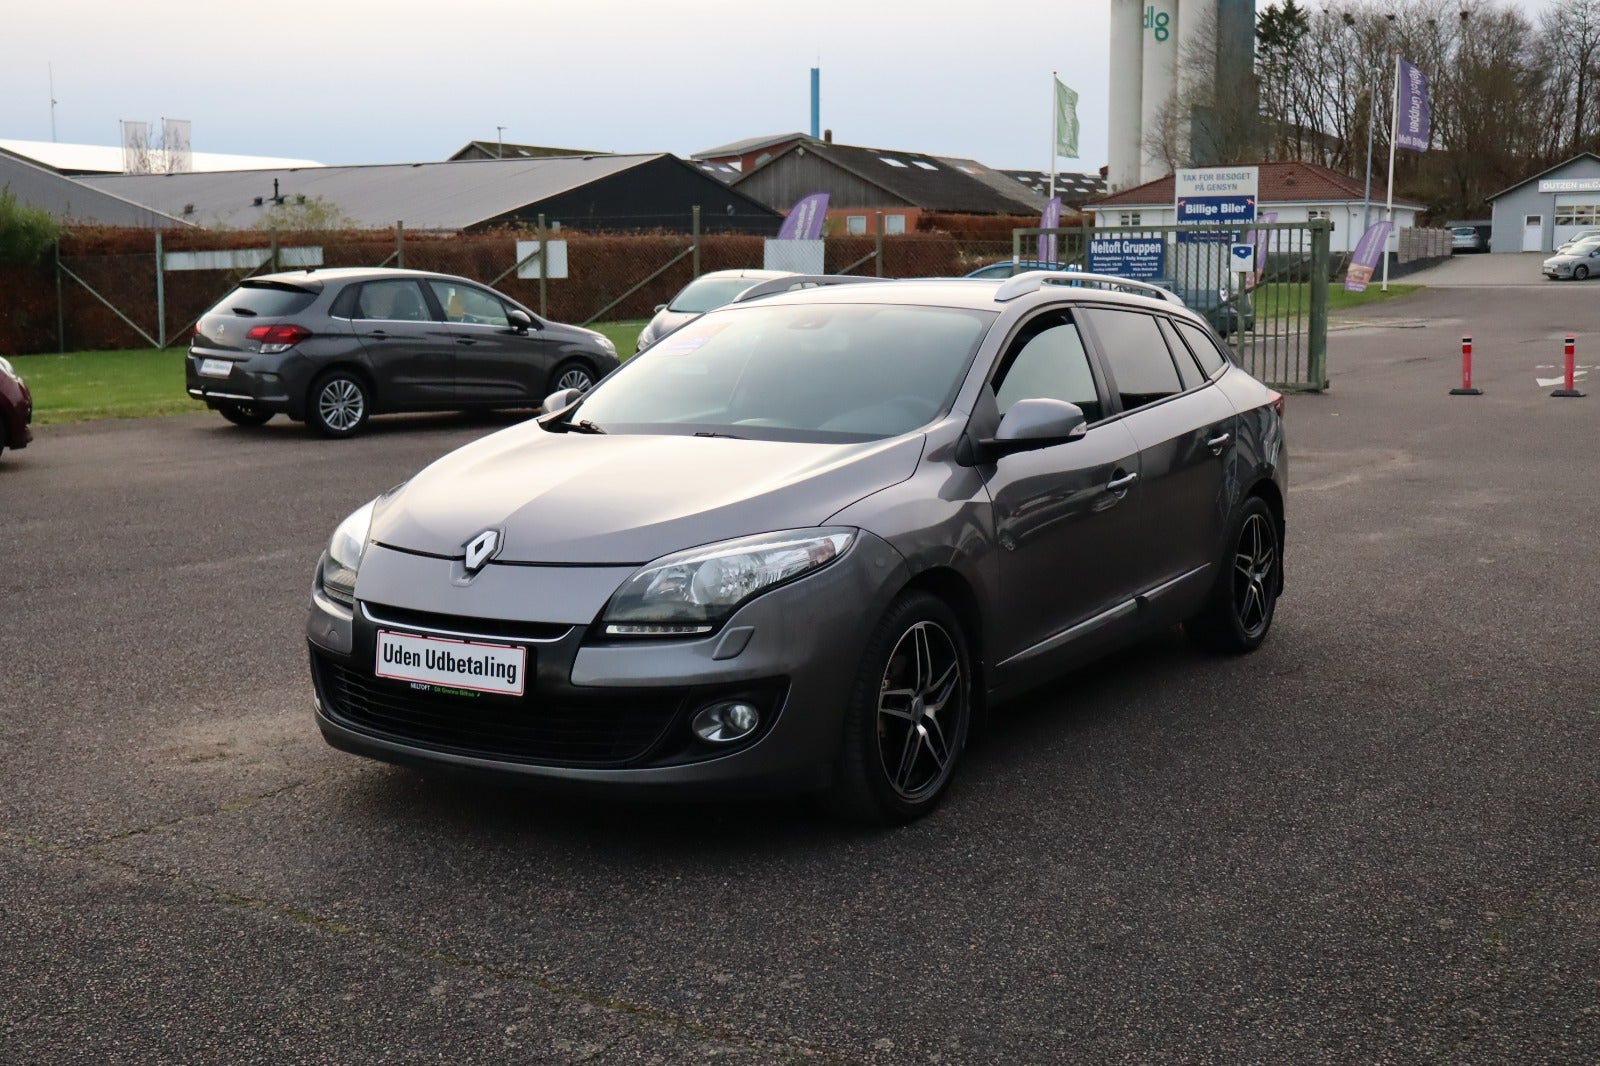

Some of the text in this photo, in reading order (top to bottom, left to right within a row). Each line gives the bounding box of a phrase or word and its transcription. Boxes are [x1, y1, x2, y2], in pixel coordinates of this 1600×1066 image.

[1408, 97, 1422, 133] Gruppen
[1183, 172, 1250, 182] TAK FOR BESØGET
[1194, 183, 1238, 191] PÅ GENSYN
[1543, 182, 1577, 190] OUTZEN
[1185, 203, 1246, 216] Billige Biler
[1091, 240, 1161, 256] Neltoft Gruppen
[383, 642, 517, 685] Uden Udbetaling
[410, 682, 431, 692] NELTOFT
